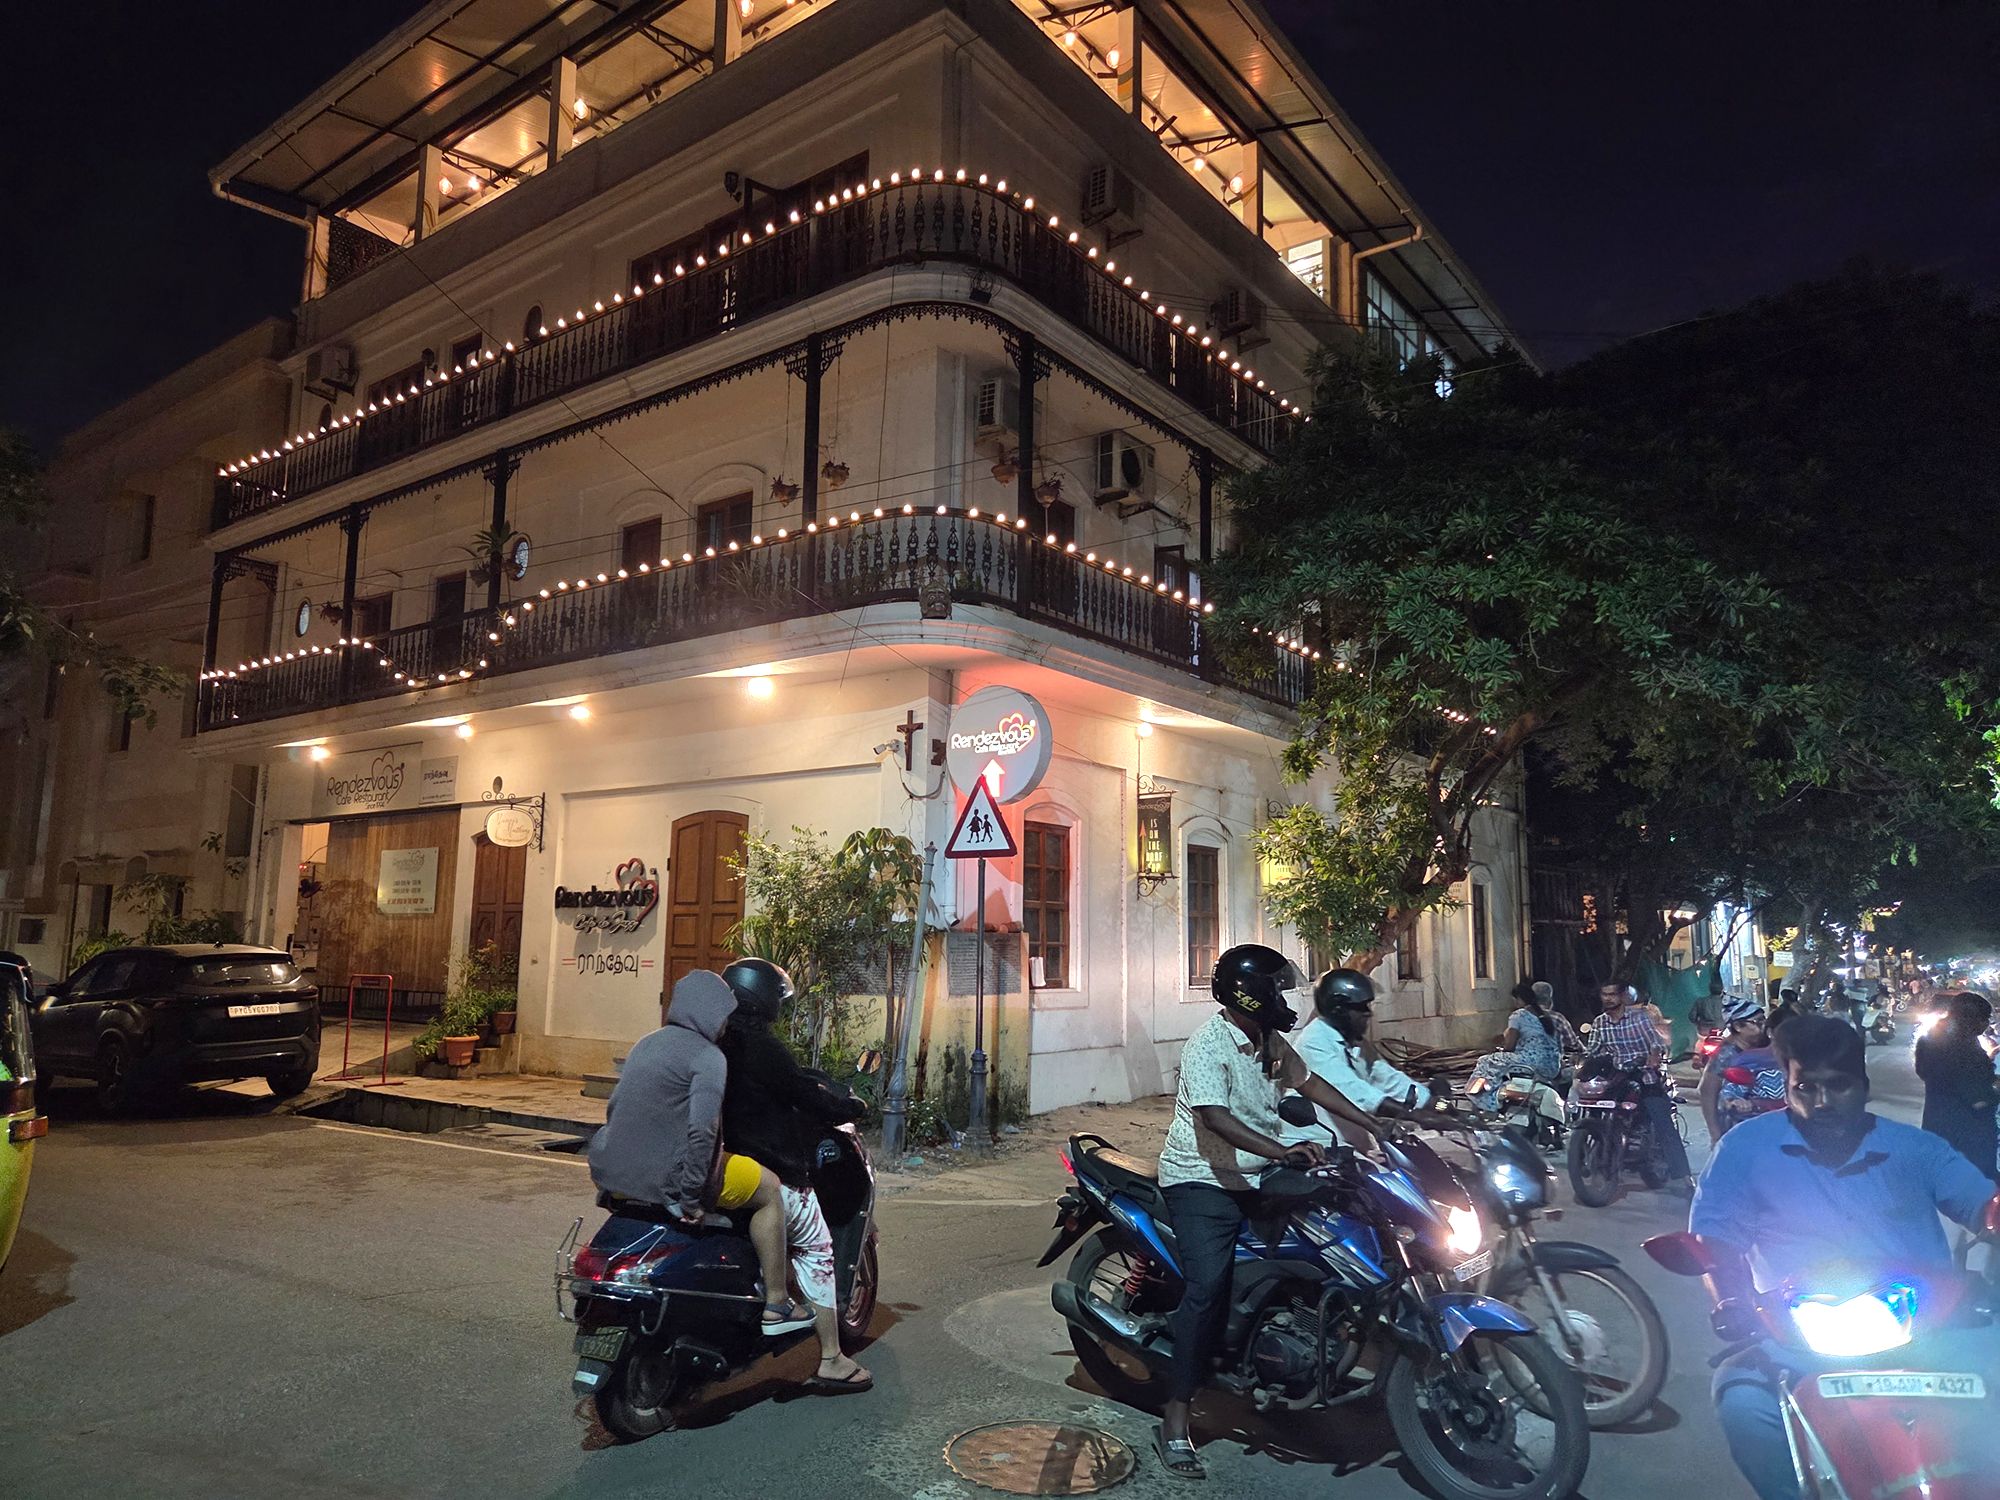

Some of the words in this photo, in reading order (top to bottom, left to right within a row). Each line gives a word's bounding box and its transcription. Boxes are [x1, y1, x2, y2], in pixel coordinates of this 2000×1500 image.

[951, 728, 1030, 750] Rendezvous
[327, 774, 400, 797] Rendezvous
[1150, 818, 1158, 828] IS
[1149, 829, 1159, 839] ON
[1148, 840, 1160, 850] THE
[555, 885, 655, 909] Rendezvous
[1938, 1377, 1975, 1395] 4327
